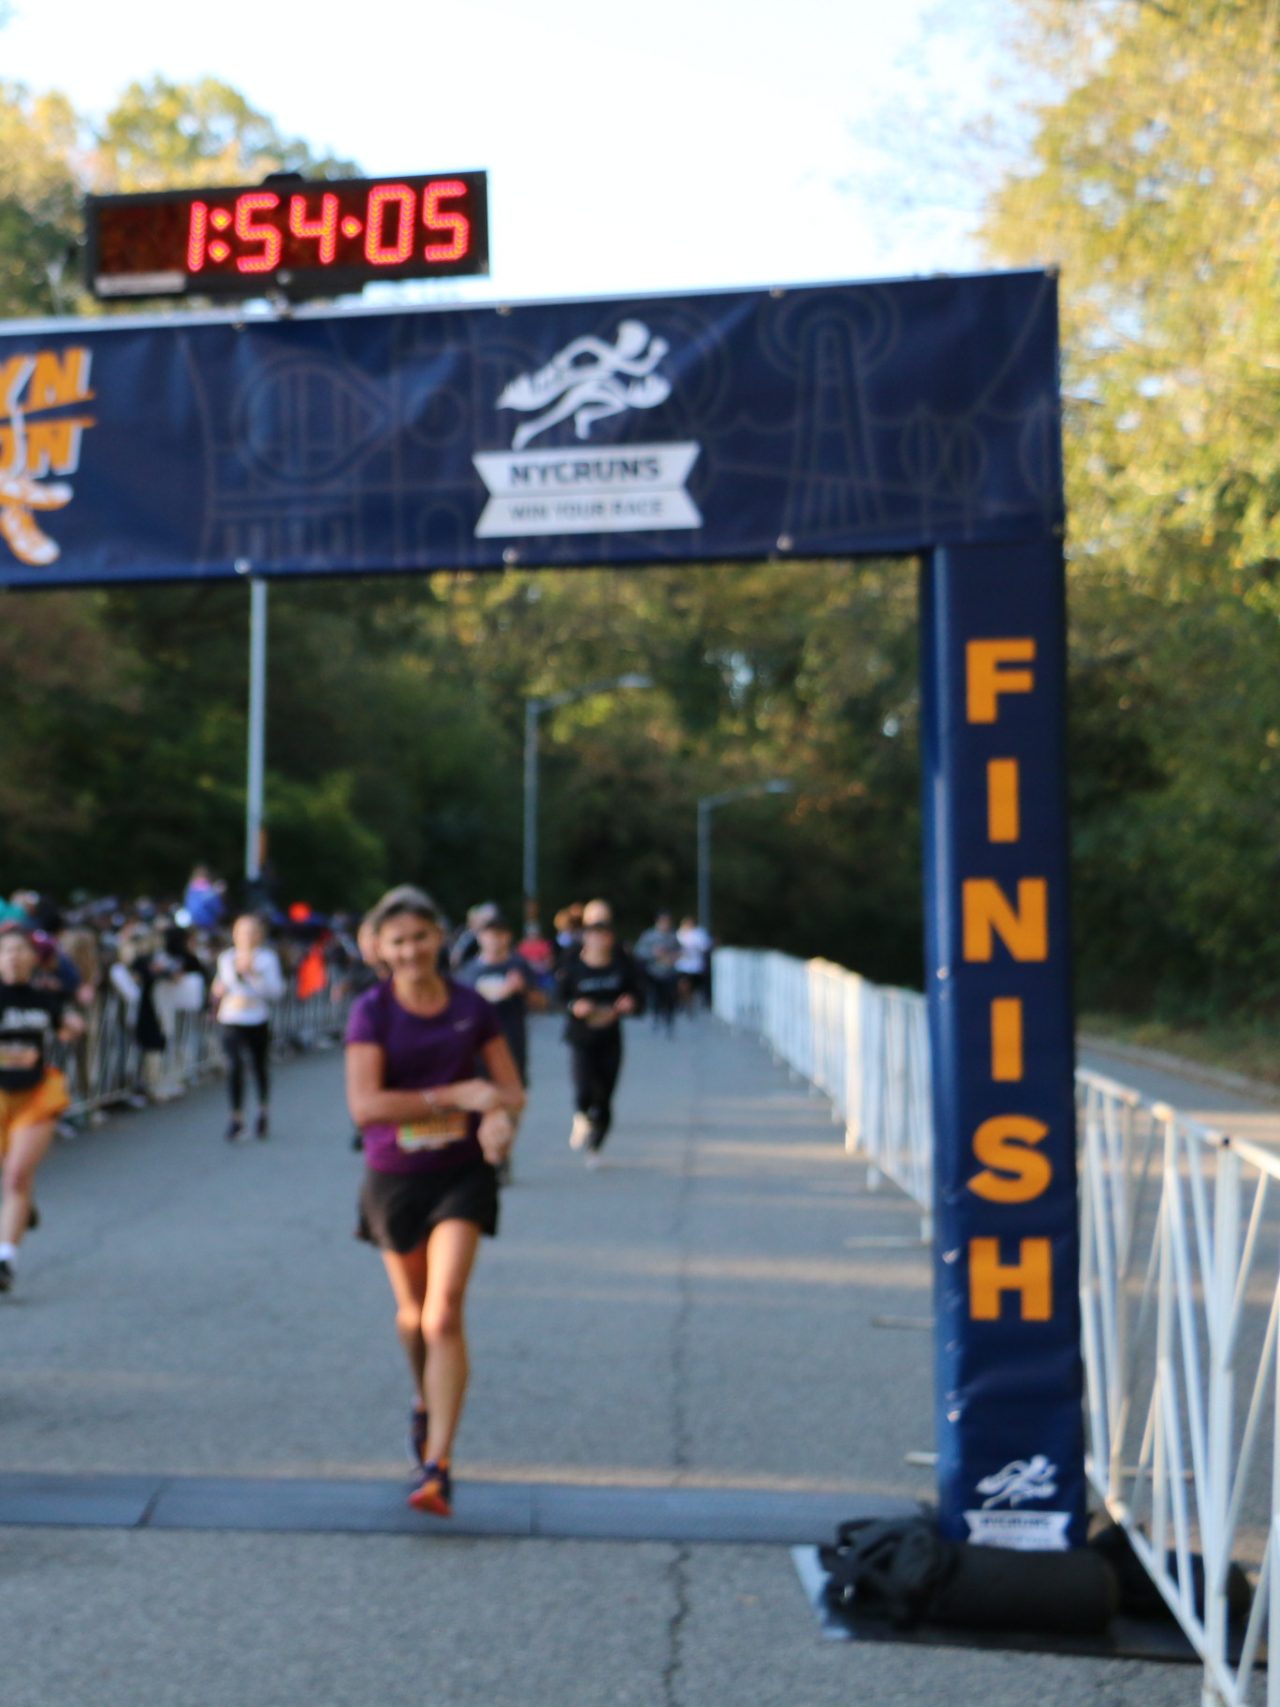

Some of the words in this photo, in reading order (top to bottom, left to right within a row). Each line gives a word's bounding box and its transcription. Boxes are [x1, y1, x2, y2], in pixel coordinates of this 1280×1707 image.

[510, 456, 661, 486] NYCRUNS
[510, 501, 547, 520] WIN
[962, 637, 1053, 1321] FINISH
